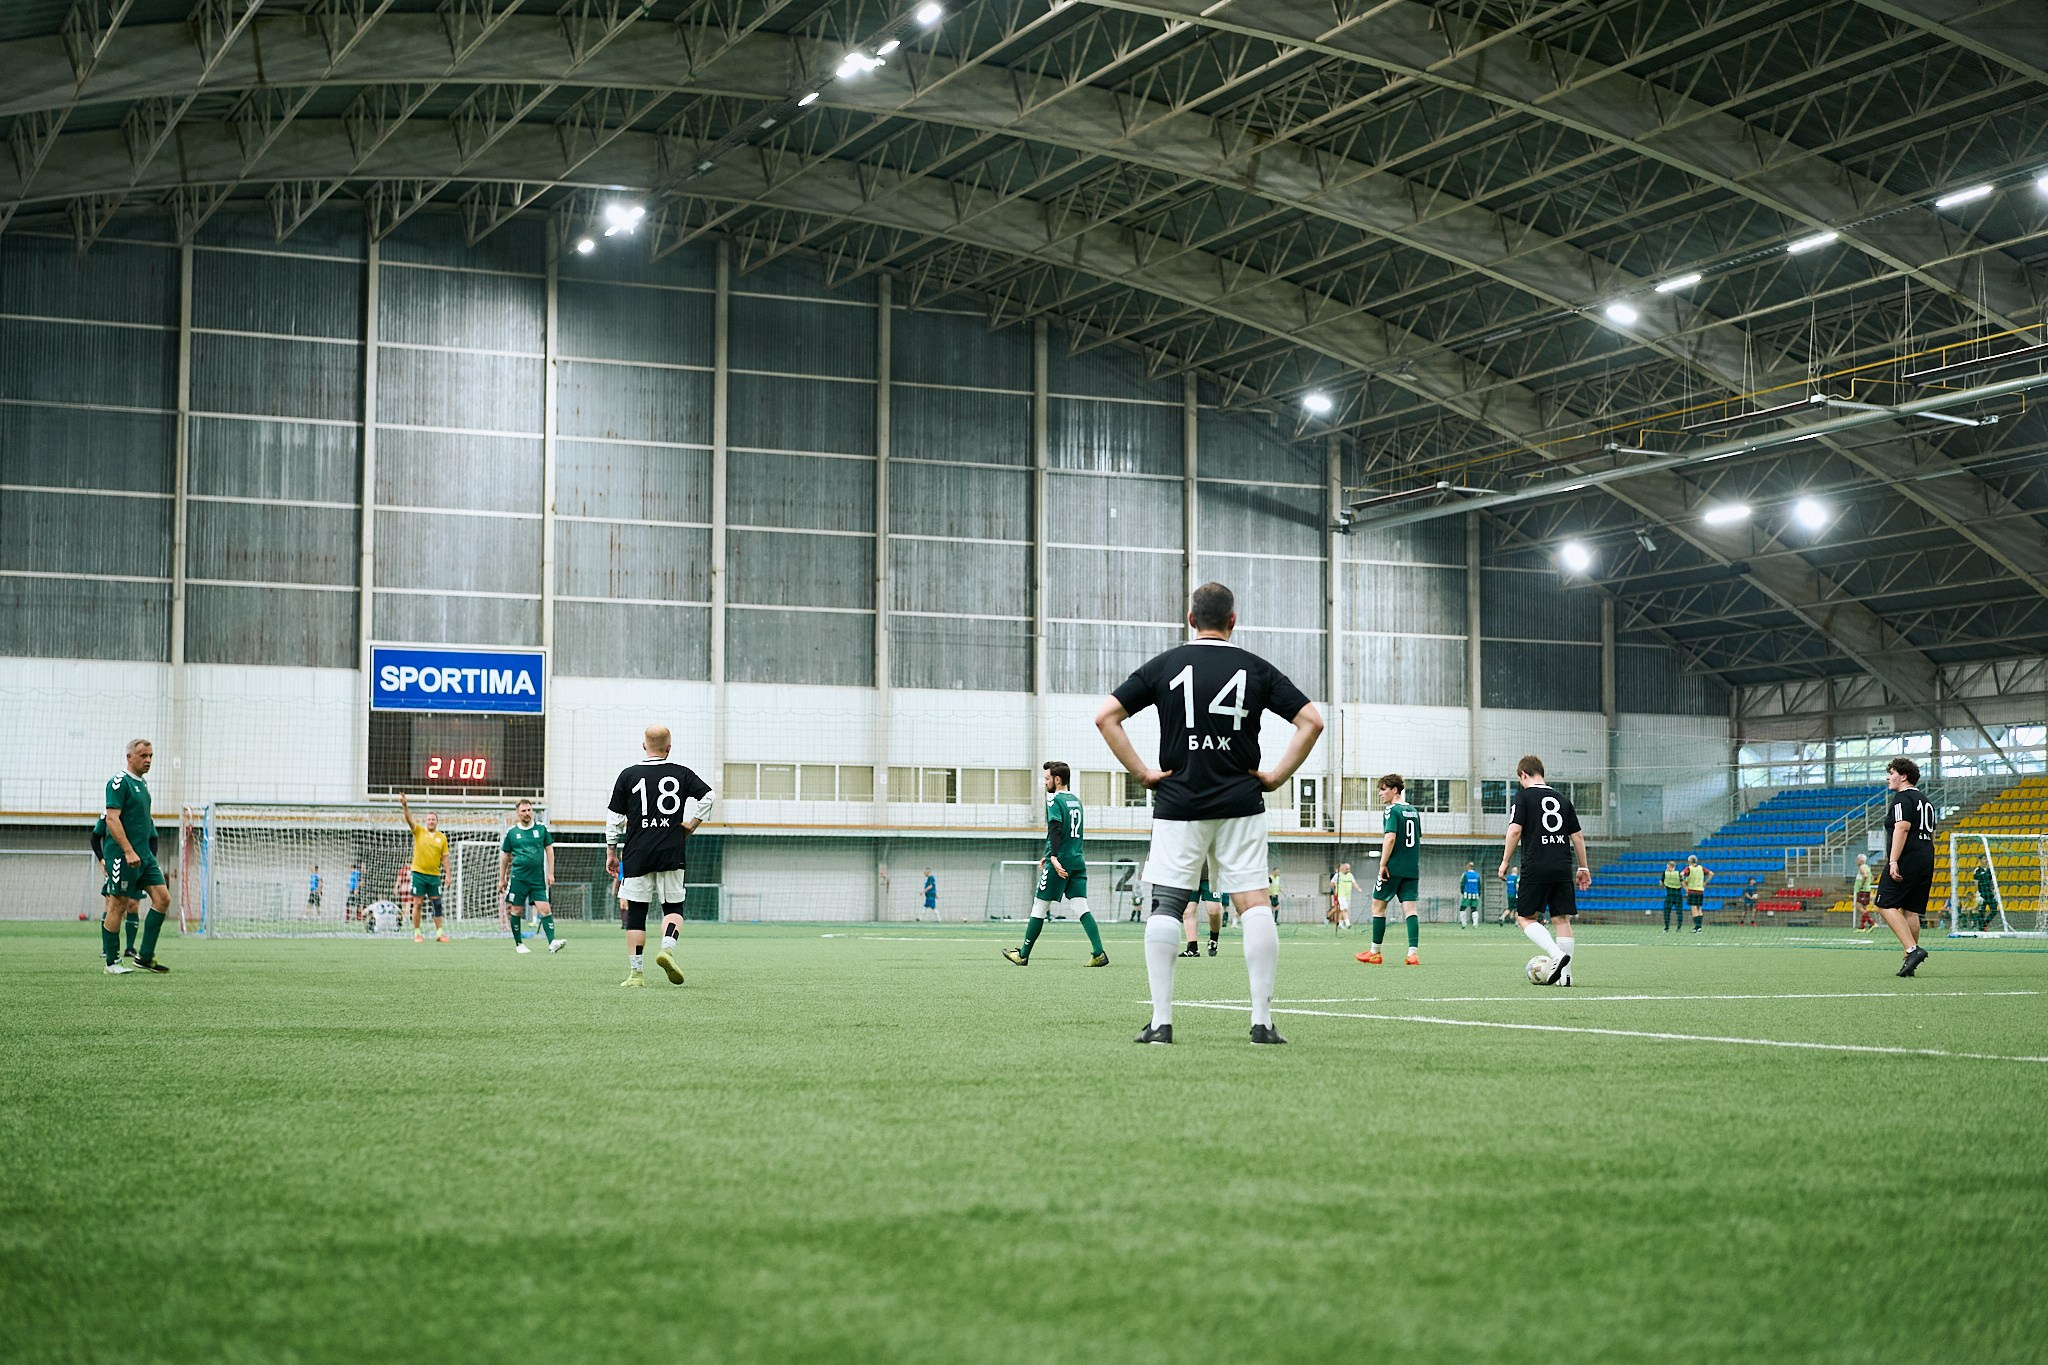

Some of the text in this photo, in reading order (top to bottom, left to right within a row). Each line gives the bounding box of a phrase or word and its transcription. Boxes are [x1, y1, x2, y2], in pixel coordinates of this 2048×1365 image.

[380, 665, 535, 695] SPORTIMA
[1169, 664, 1249, 731] 14
[1188, 735, 1231, 750] БАЖ
[631, 776, 681, 816] 18
[641, 817, 670, 828] БАЖ
[1069, 808, 1082, 838] 12
[1541, 796, 1563, 832] 8
[1916, 799, 1935, 833] 10
[1405, 819, 1416, 848] 9
[1541, 834, 1565, 845] БАЖ
[1115, 858, 1136, 891] 2
